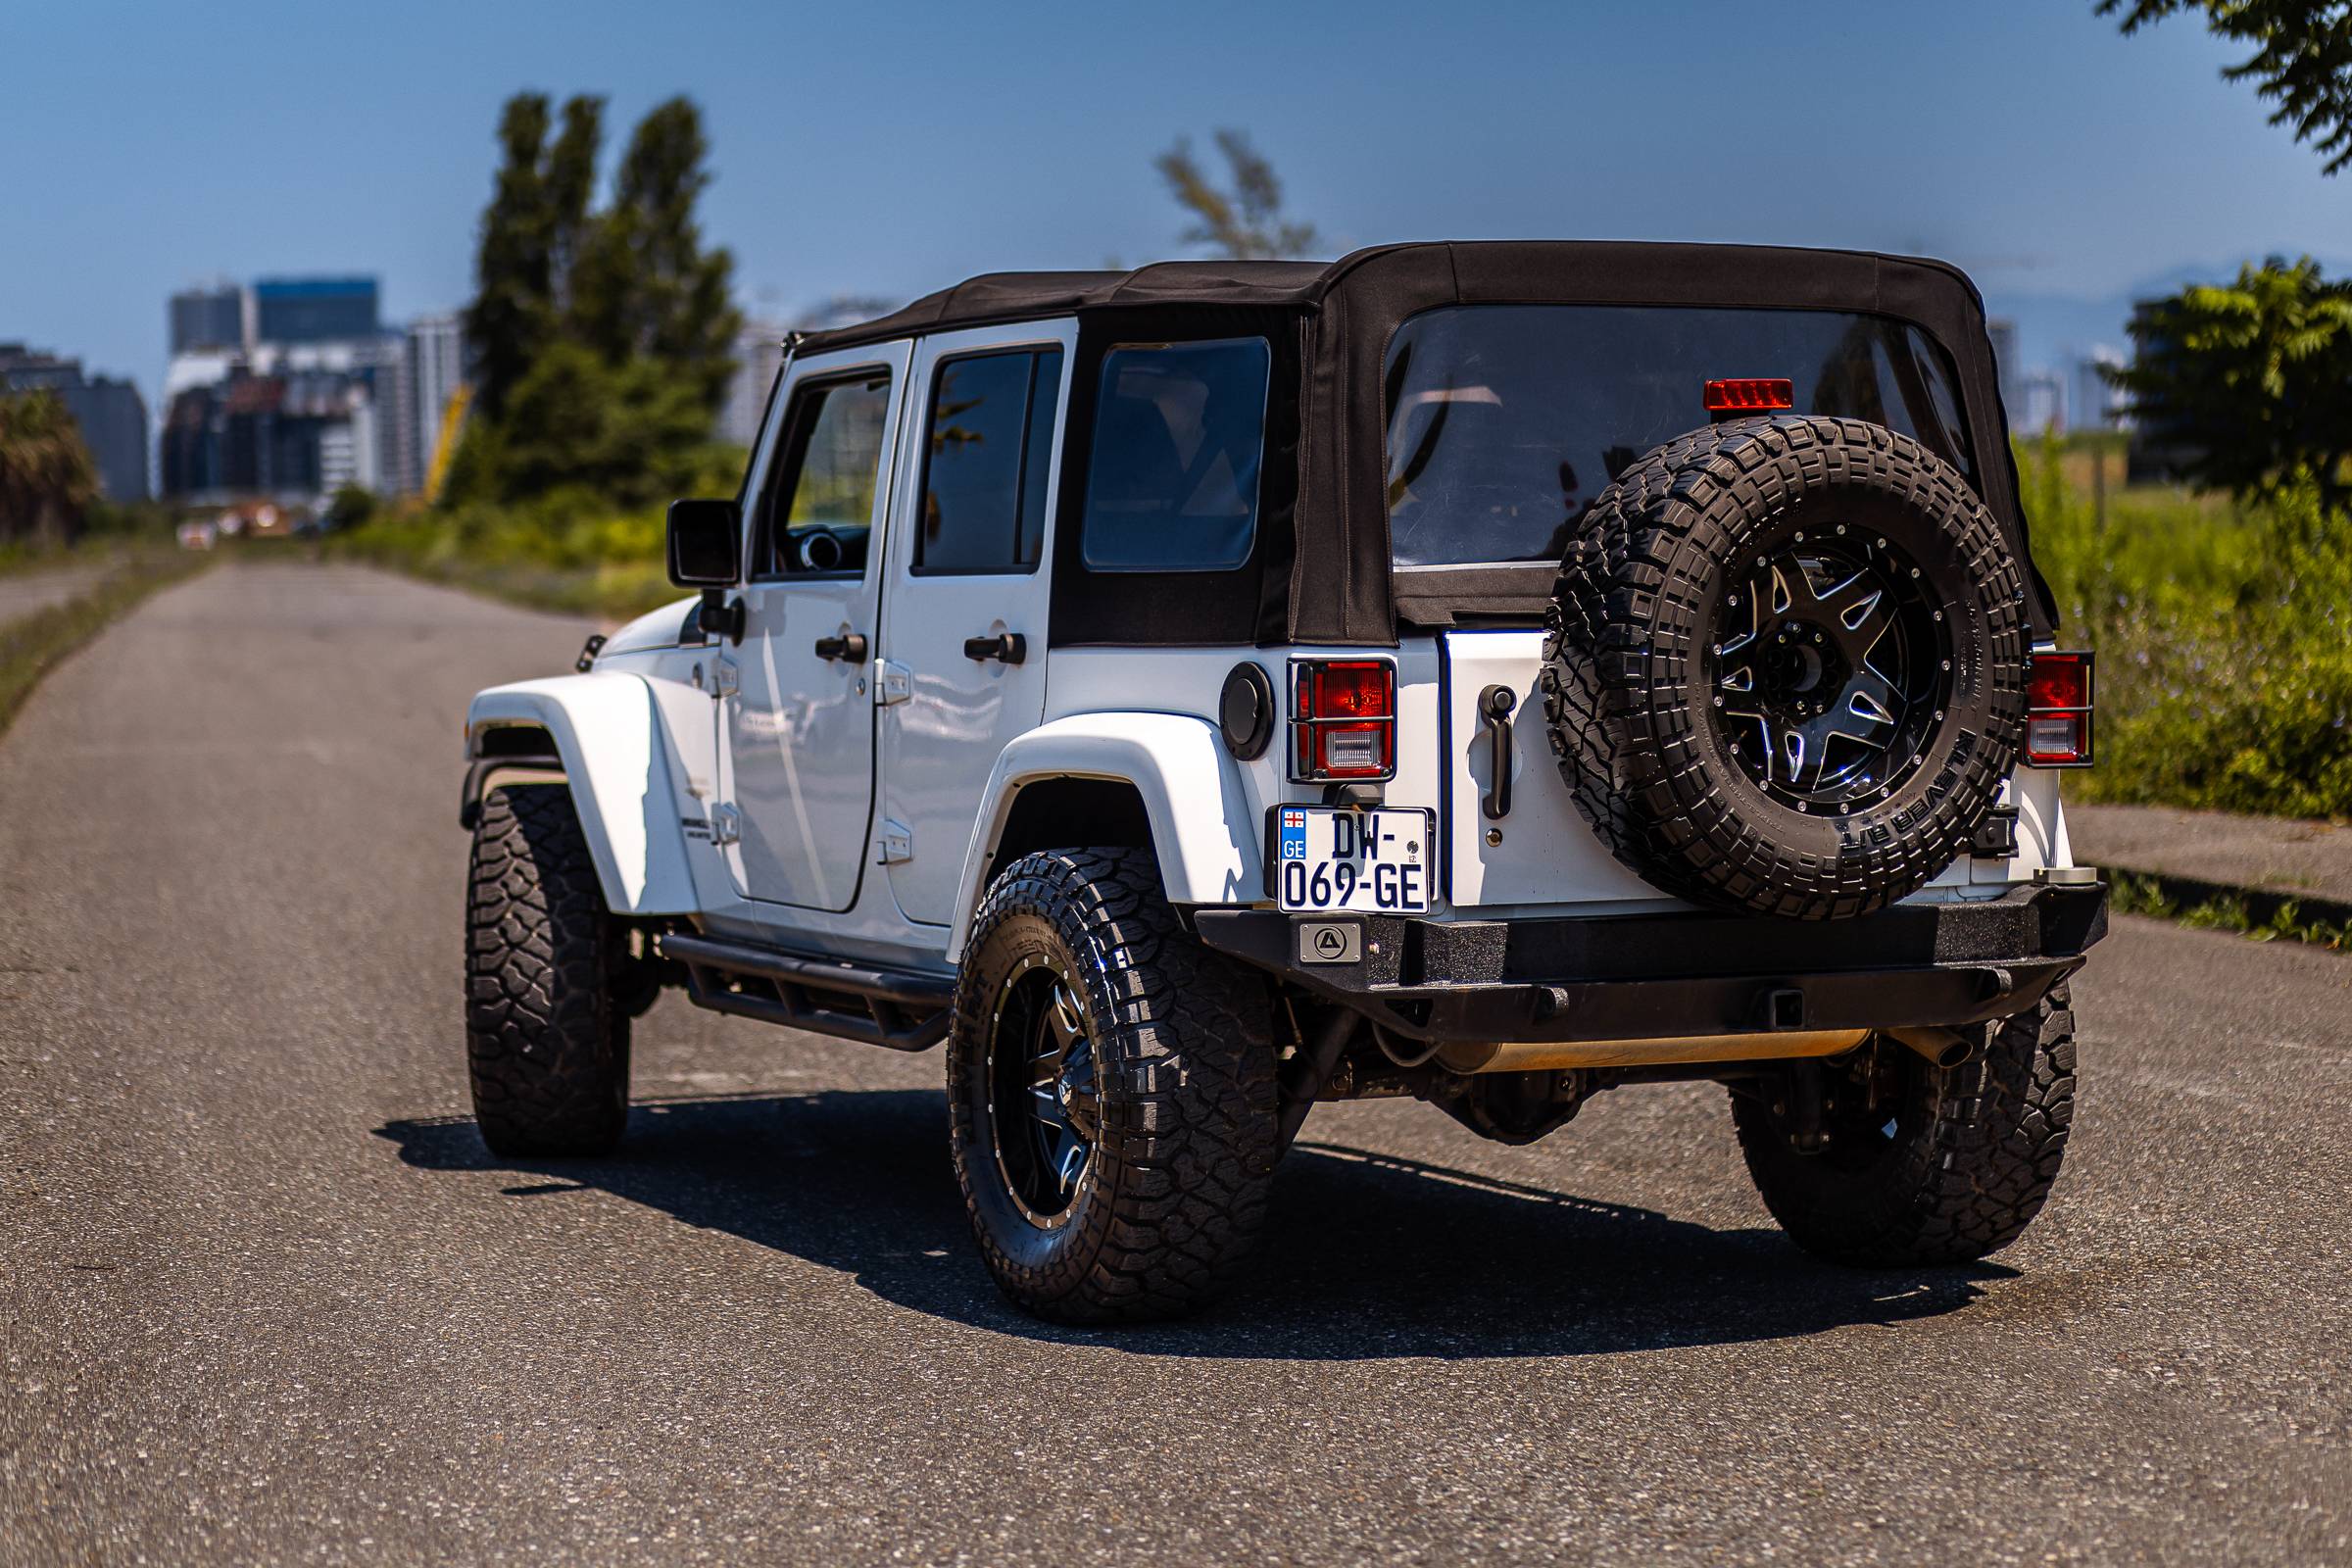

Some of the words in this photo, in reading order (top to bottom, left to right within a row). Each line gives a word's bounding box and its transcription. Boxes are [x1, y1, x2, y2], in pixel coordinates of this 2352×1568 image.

[1890, 727, 1977, 832] KLEVER
[1284, 840, 1304, 858] GE
[1285, 860, 1424, 909] 069-GE
